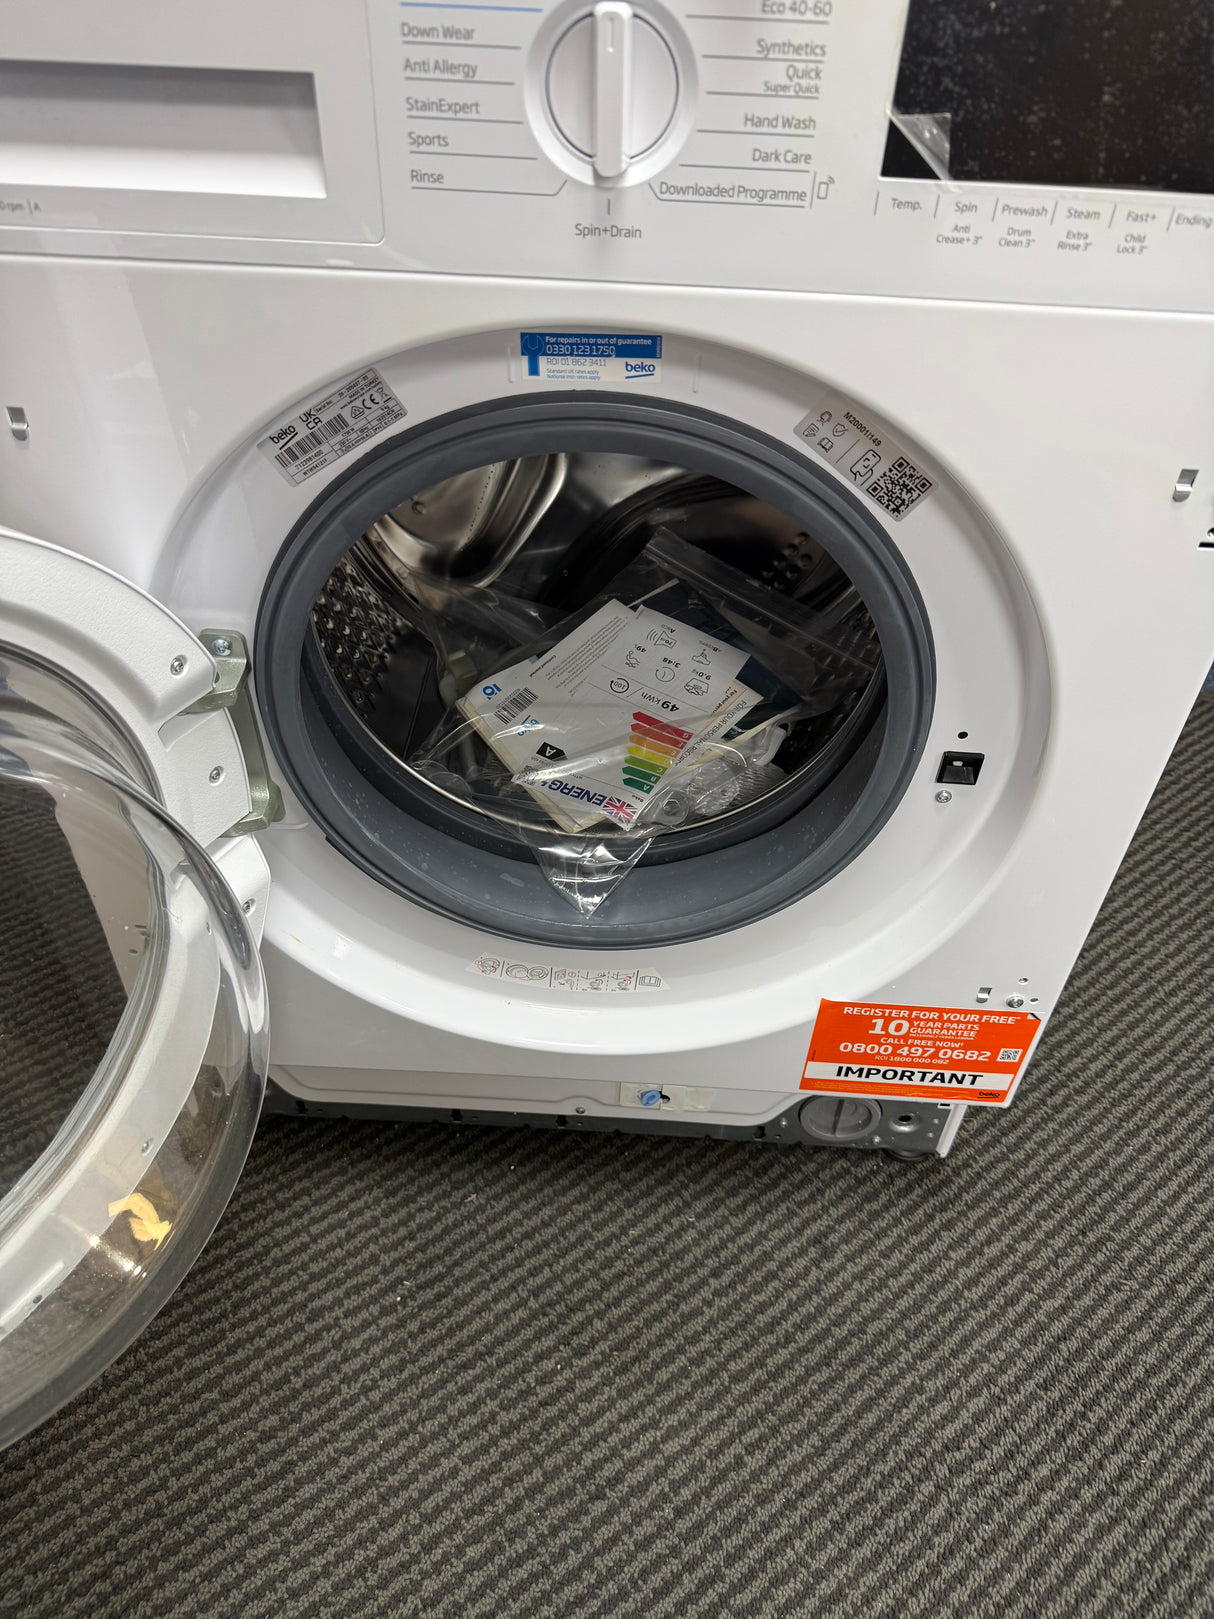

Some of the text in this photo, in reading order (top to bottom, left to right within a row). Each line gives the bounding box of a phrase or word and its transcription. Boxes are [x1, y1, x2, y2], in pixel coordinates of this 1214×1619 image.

[761, 0, 832, 17] Eco 40-60
[401, 22, 475, 41] Down Wear
[757, 38, 826, 58] Synthetics
[404, 58, 478, 79] Anti Allergy
[786, 64, 822, 81] Quick
[763, 81, 820, 96] Super Quick
[406, 97, 480, 115] StainExpert
[744, 113, 816, 131] Hand Wash
[408, 131, 449, 149] Sports
[752, 148, 812, 165] Dark Care
[410, 169, 444, 184] Rinse
[659, 182, 808, 203] Downloaded Programme
[891, 197, 923, 212] Temp.
[954, 201, 978, 214] Spin
[1001, 203, 1048, 218] Prewash
[1066, 207, 1101, 221] Steam
[1125, 210, 1158, 223] Fast+
[1175, 213, 1213, 229] Ending
[575, 223, 642, 240] Spin+Drain
[952, 224, 971, 234] Anti
[1007, 226, 1031, 237] Drum
[1066, 230, 1089, 241] Extra
[936, 233, 972, 246] Crease+
[998, 236, 1023, 248] Clean
[1056, 240, 1081, 251] Rinse
[1124, 233, 1146, 244] Child
[1116, 244, 1137, 255] Lock
[545, 336, 556, 344] For
[557, 337, 580, 345] repairs
[617, 338, 652, 346] guarantee
[546, 344, 616, 356] 0330 123 1750
[546, 358, 607, 367] ROI 01 862 3411
[625, 361, 656, 373] beko
[299, 407, 317, 424] UK
[269, 424, 297, 445] beko
[662, 656, 681, 669] 3:48
[698, 671, 712, 681] 9.0
[613, 680, 627, 689] 100
[641, 691, 680, 713] 49 kWh
[719, 711, 737, 725] YOUR
[545, 746, 557, 757] A
[843, 1007, 910, 1018] REGISTER
[911, 1010, 939, 1020] FOR
[942, 1012, 980, 1023] YOUR
[868, 1018, 910, 1036] 10
[909, 1027, 977, 1038] GUARANTEE
[912, 1020, 980, 1031] YEAR PARTS
[880, 1037, 906, 1046] CALL
[907, 1039, 934, 1047] FREE
[839, 1042, 992, 1062] 0800 497 0682
[836, 1066, 983, 1086] IMPORTANT
